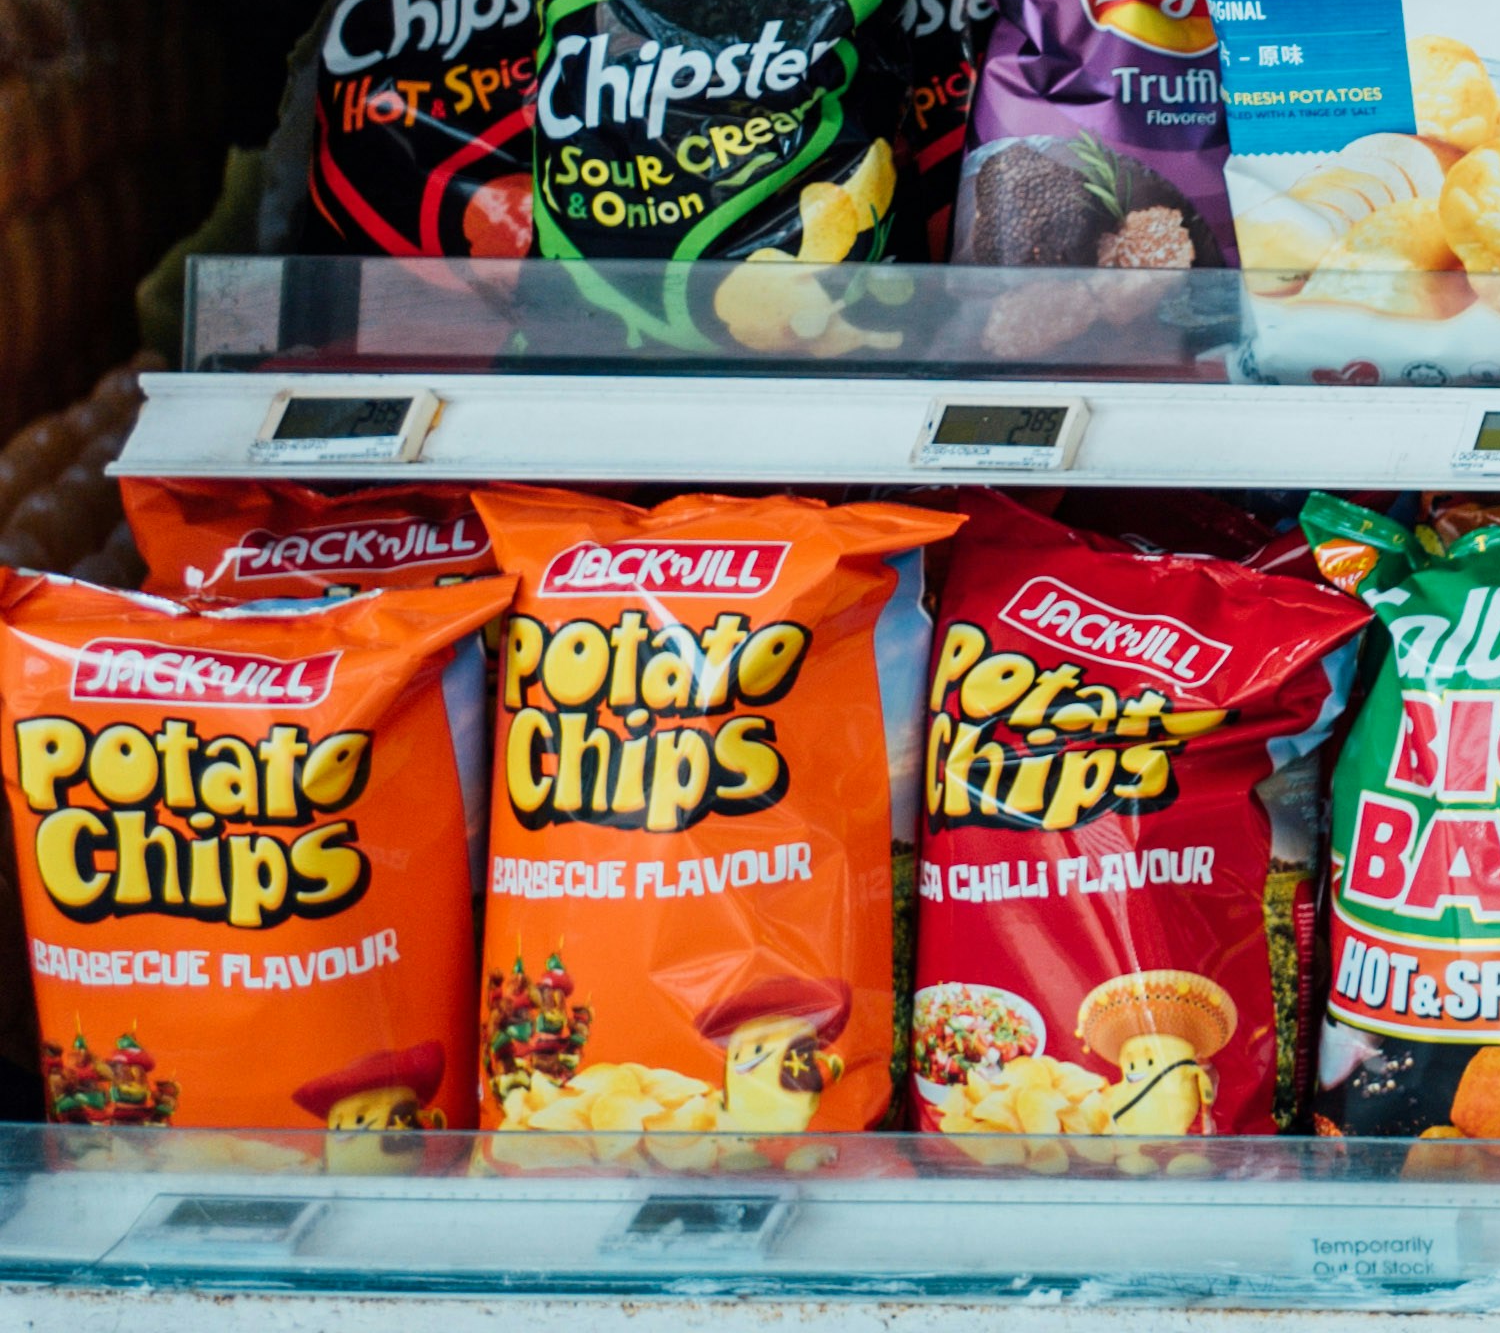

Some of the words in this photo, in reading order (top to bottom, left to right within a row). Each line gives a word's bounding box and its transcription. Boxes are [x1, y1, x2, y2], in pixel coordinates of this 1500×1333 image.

[535, 18, 839, 137] Chipster
[1233, 91, 1279, 107] FRESH
[1280, 86, 1382, 105] POTATOES
[1146, 109, 1217, 126] Flavored
[15, 718, 371, 823] Potato
[35, 806, 371, 929] Chips
[33, 941, 211, 990] BARBECUE
[221, 927, 401, 991] FLAVOUR
[1310, 1234, 1435, 1259] Temporarily
